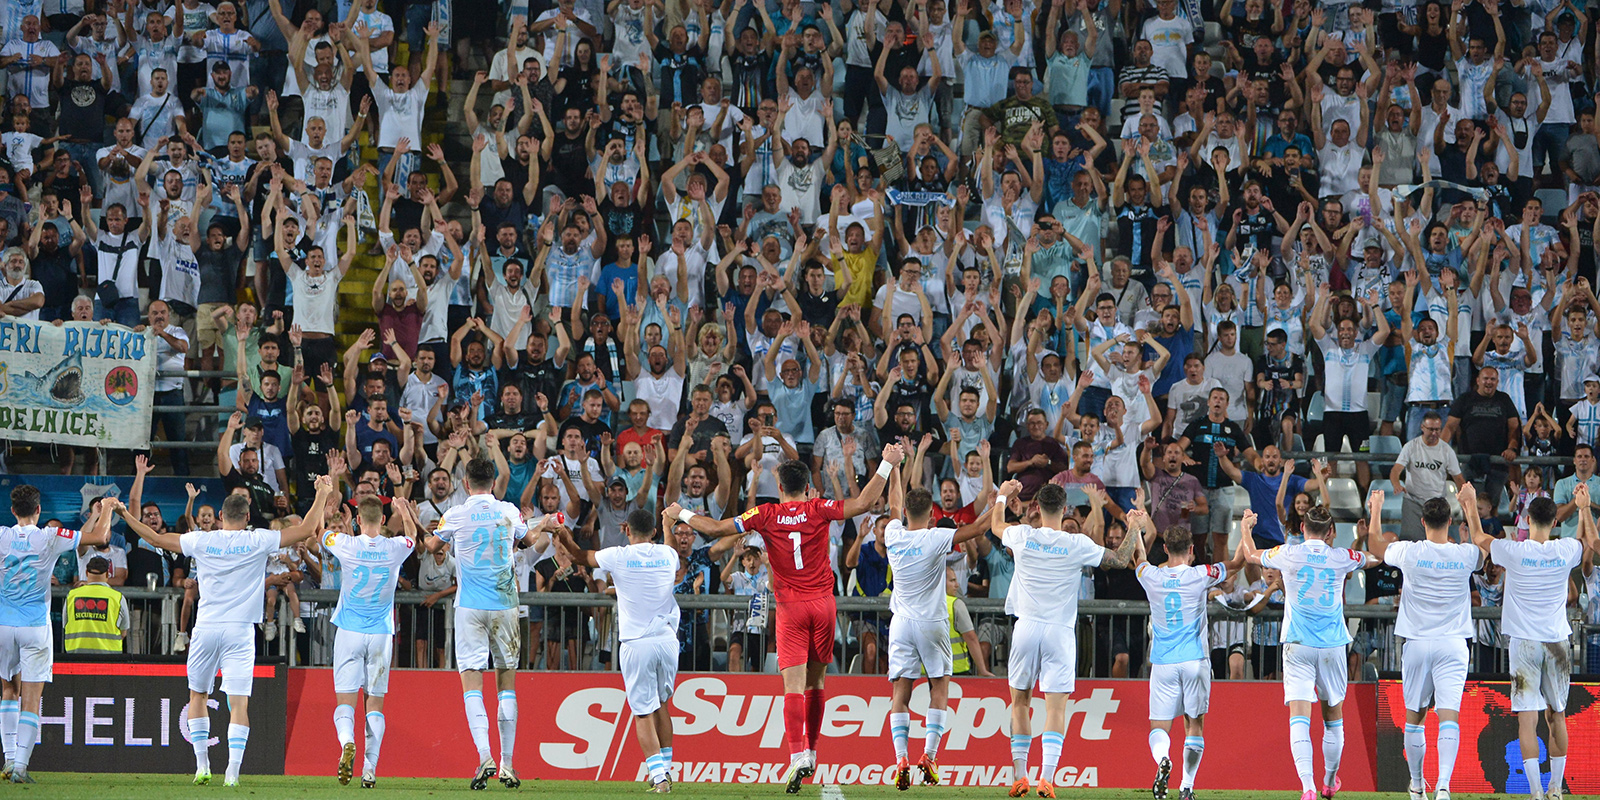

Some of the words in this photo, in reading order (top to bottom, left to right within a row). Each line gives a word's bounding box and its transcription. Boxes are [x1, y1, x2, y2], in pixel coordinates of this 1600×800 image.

[1415, 461, 1437, 471] JAKO
[205, 546, 222, 556] HNK
[472, 525, 509, 567] 26
[788, 531, 804, 570] 1
[1024, 540, 1041, 551] HNK
[1042, 545, 1069, 556] RIJEKA
[626, 560, 643, 568] HNK
[645, 559, 671, 568] RIJEKA
[1416, 559, 1433, 569] HNK
[1436, 561, 1465, 570] RIJEKA
[1521, 558, 1538, 568] HNK
[1540, 559, 1567, 568] RIJEKA
[349, 565, 390, 604] 27
[1297, 565, 1336, 607] 23
[75, 612, 107, 620] SECURITAS
[1165, 591, 1184, 631] 8
